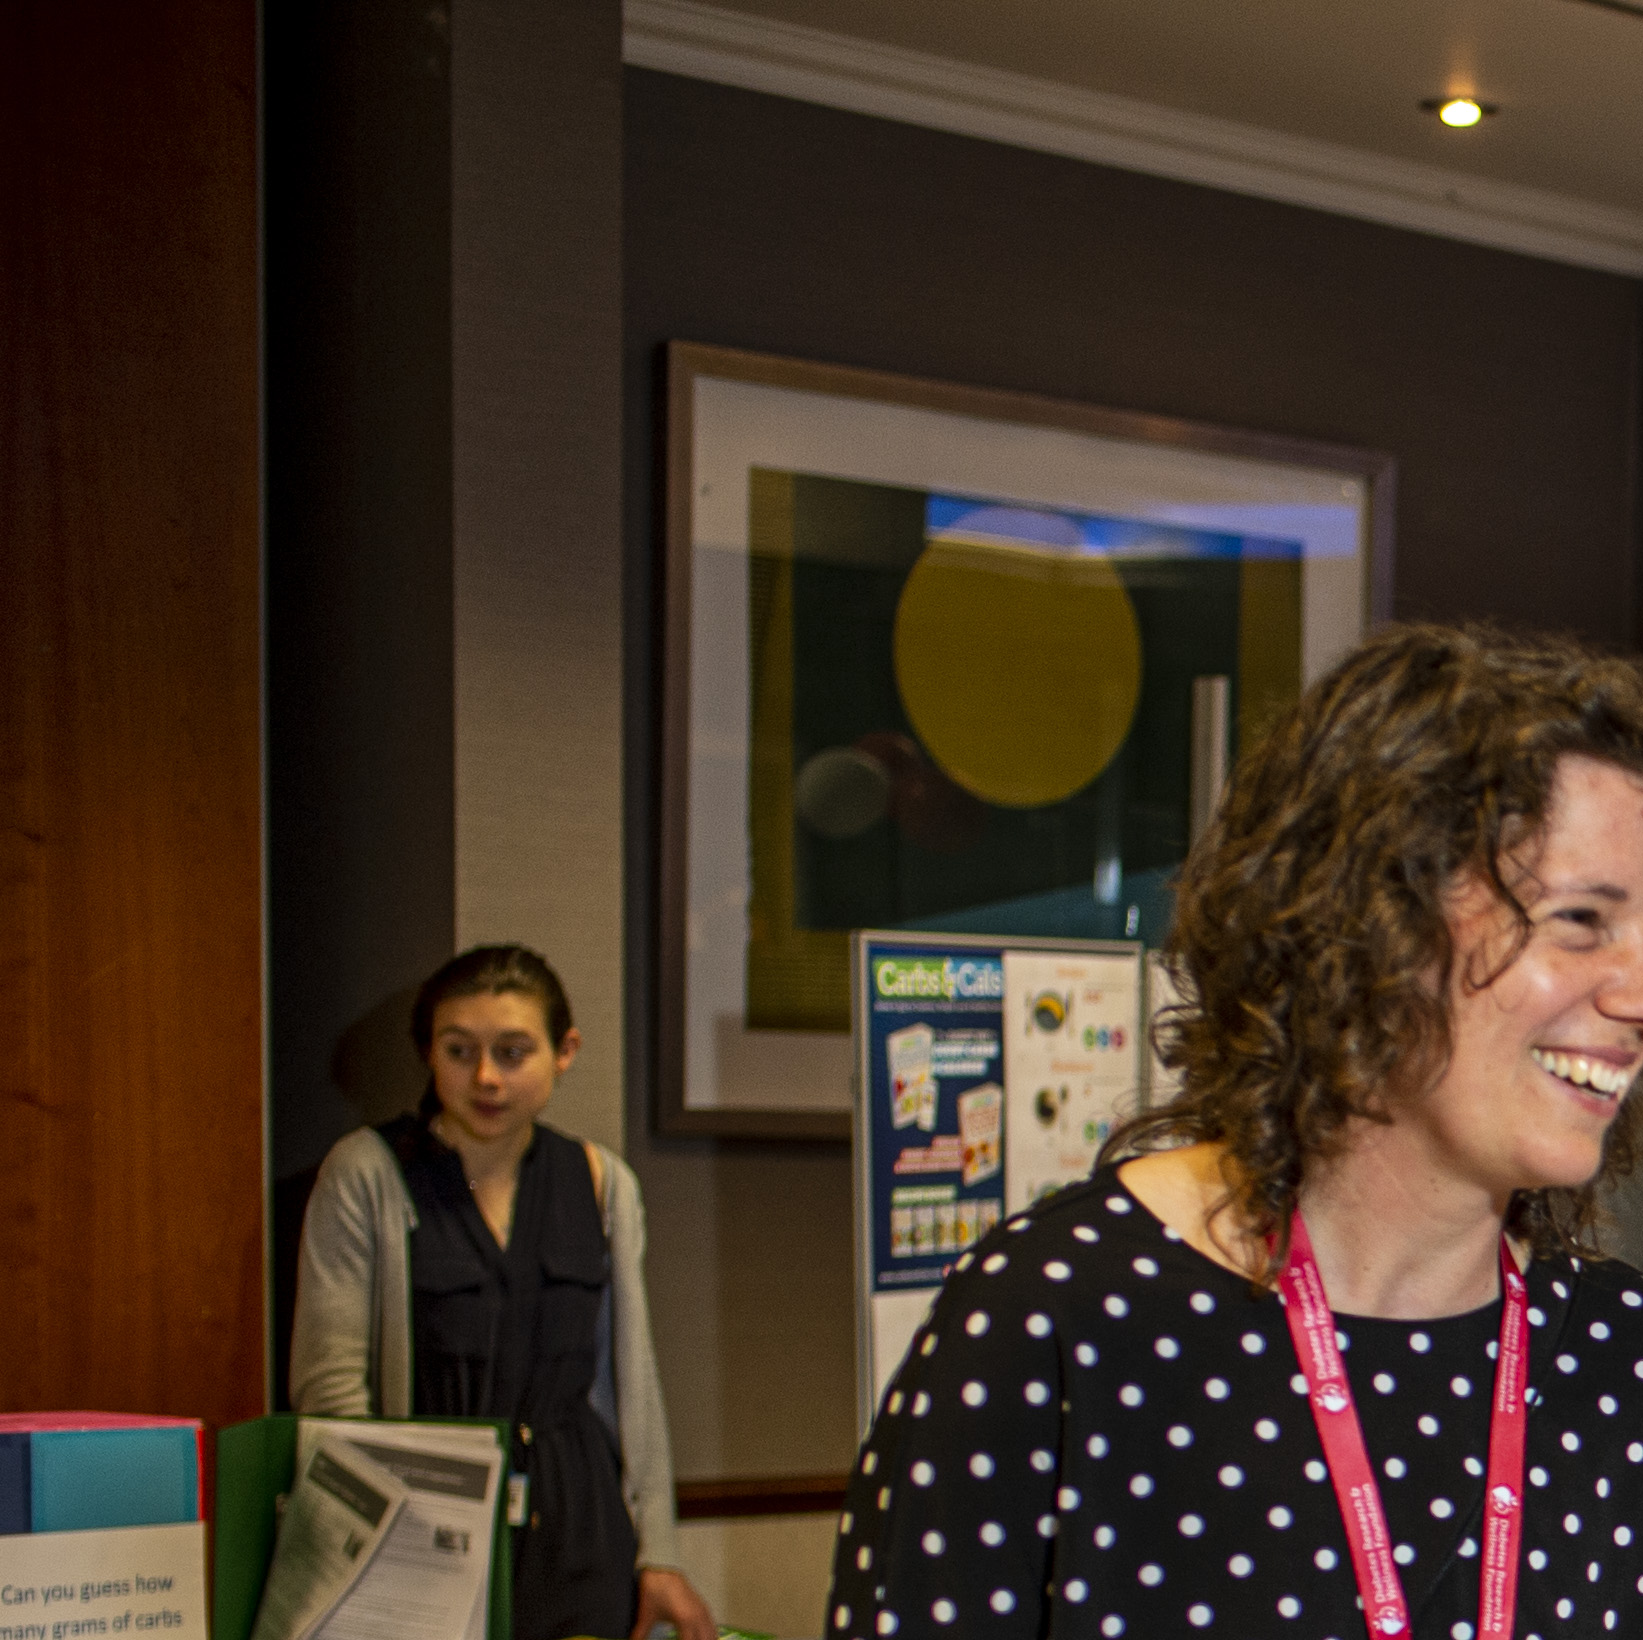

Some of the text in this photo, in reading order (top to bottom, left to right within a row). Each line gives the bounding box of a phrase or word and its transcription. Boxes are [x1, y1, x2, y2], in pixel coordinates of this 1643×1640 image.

[877, 961, 940, 996] Carbs
[1294, 1277, 1315, 1328] Research
[1308, 1329, 1327, 1380] Diabetes
[1354, 1499, 1373, 1550] Research
[1362, 1483, 1384, 1548] Foundation
[1498, 1519, 1509, 1567] Diabetes
[1, 1573, 173, 1606] Can you guess how
[1368, 1551, 1386, 1603] Diabetes
[1495, 1570, 1505, 1619] Research
[112, 1609, 131, 1632] of
[135, 1608, 183, 1630] carbs
